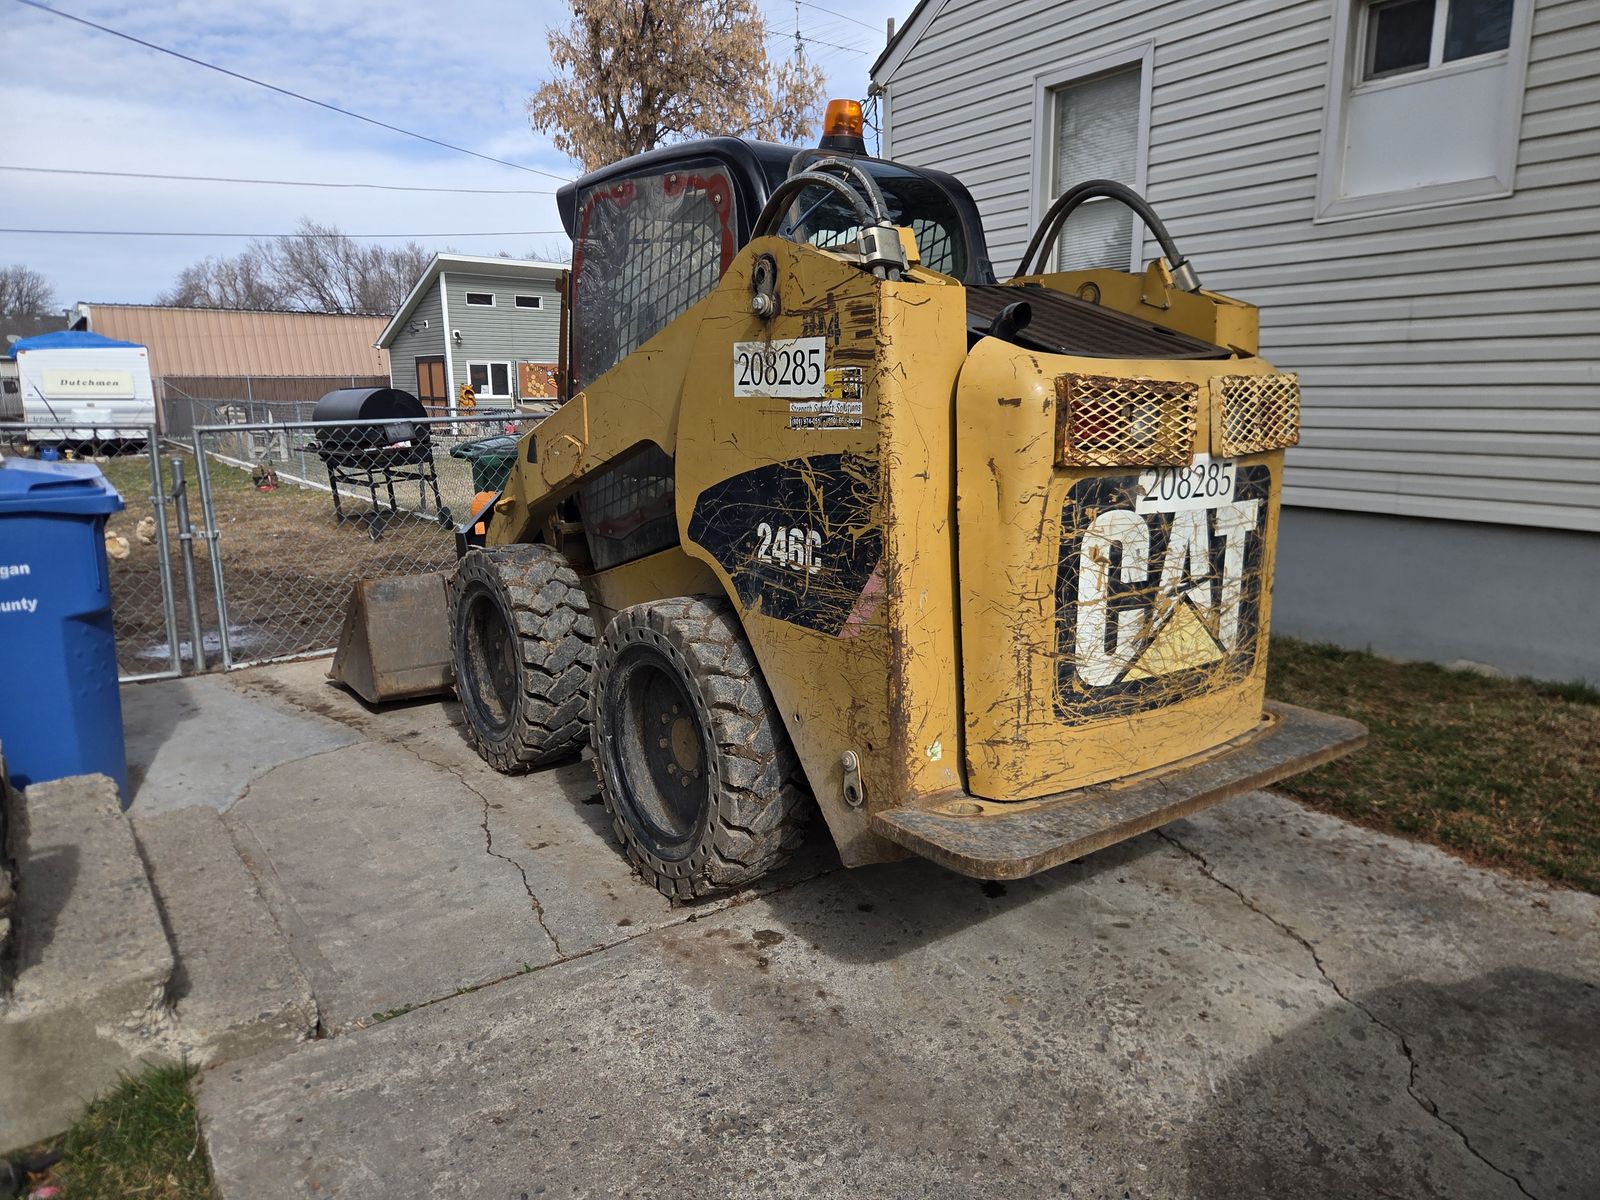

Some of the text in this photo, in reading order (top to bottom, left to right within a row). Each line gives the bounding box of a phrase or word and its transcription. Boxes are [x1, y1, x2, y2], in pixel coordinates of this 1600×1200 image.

[738, 349, 820, 386] 208285
[1143, 462, 1232, 502] 208285
[757, 522, 822, 575] 246C
[0, 597, 38, 612] unty
[1075, 499, 1259, 687] CAT
